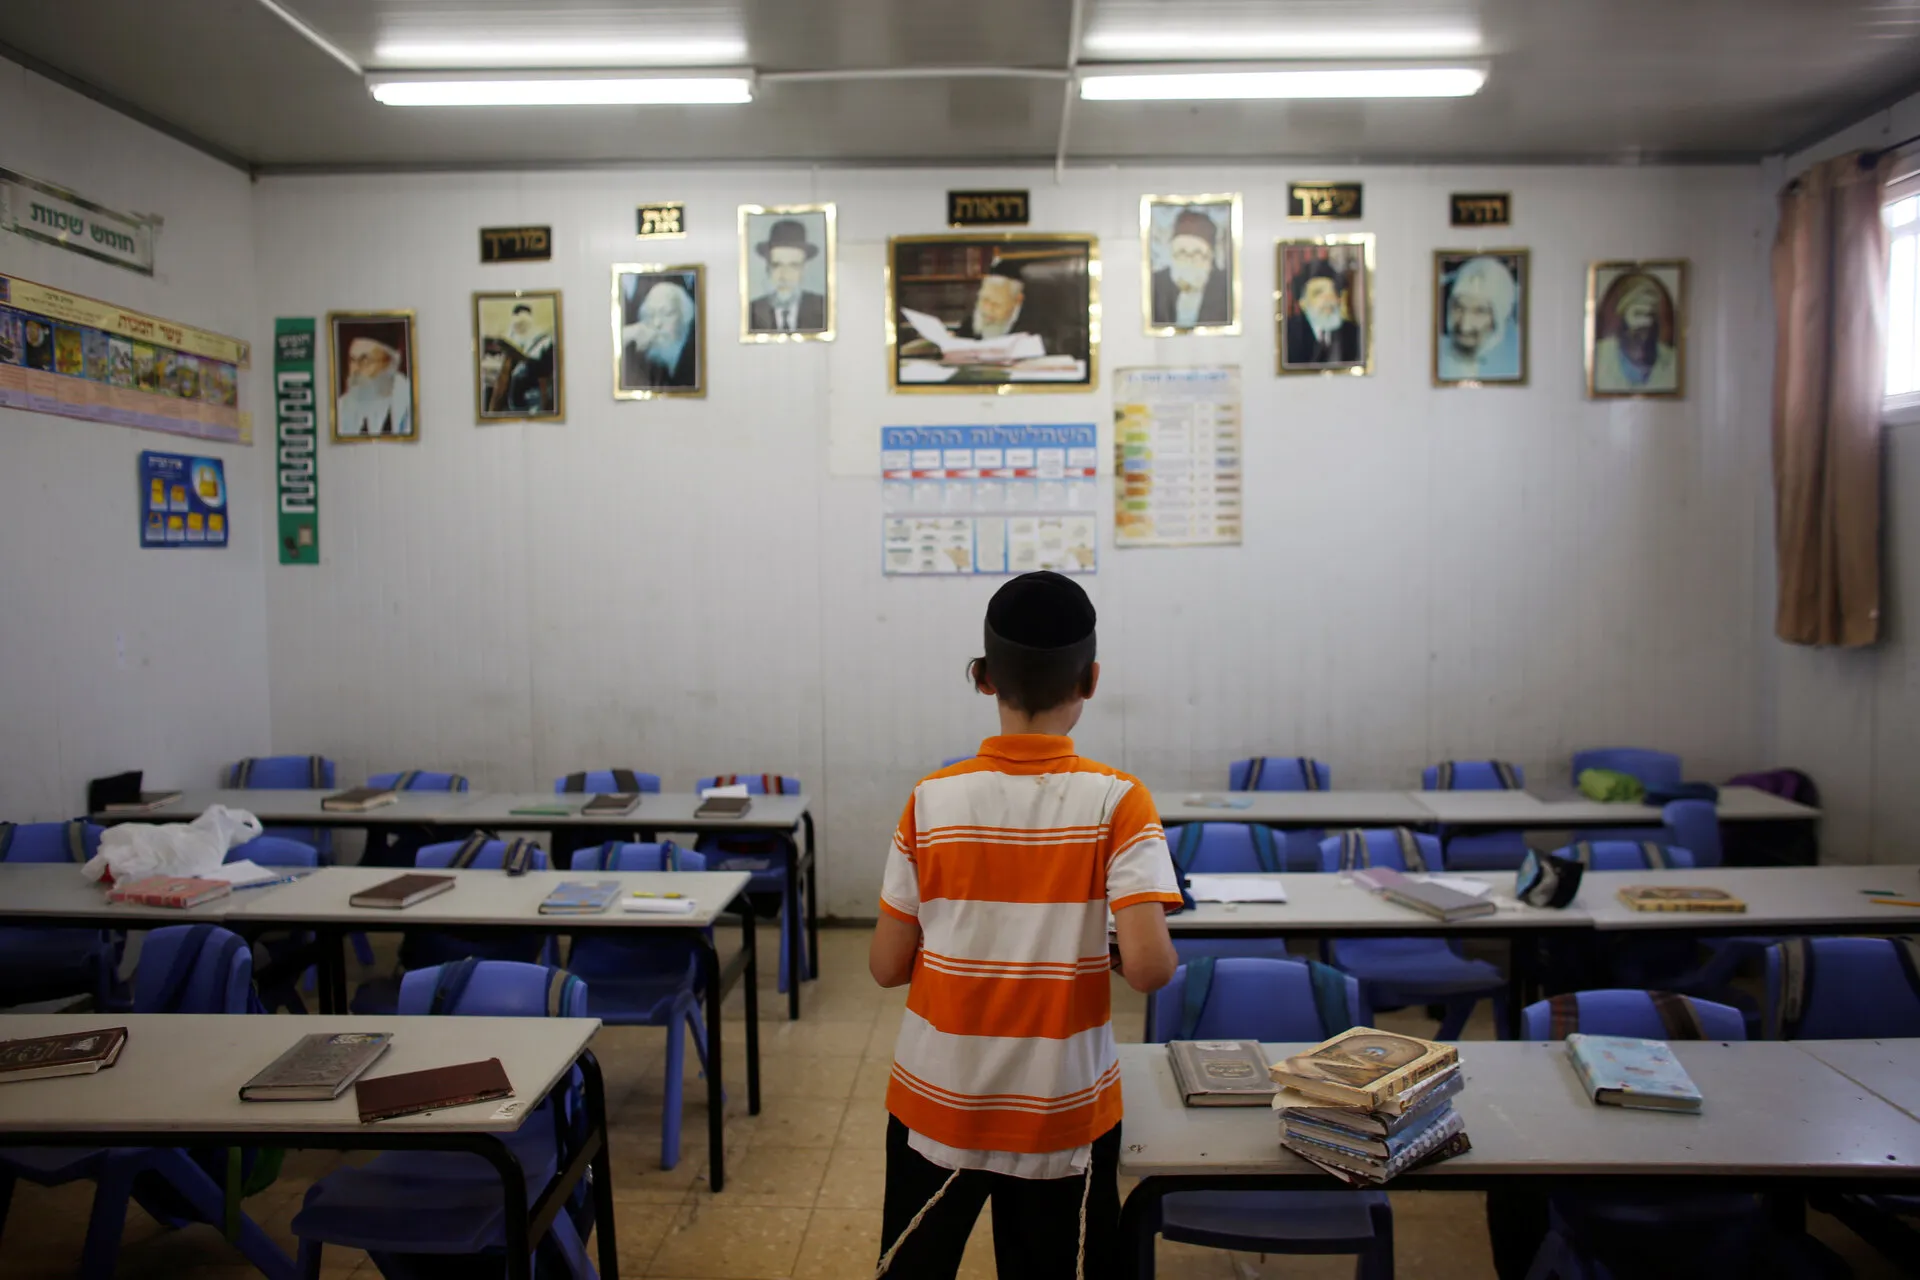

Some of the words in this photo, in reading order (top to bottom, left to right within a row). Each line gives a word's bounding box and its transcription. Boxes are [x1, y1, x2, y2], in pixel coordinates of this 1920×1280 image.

[30, 201, 84, 236] שמות
[640, 207, 680, 234] את
[90, 223, 135, 253] חומש
[484, 229, 547, 259] מוריך
[888, 427, 964, 446] ההלכה
[970, 424, 1093, 445] השתלשלות
